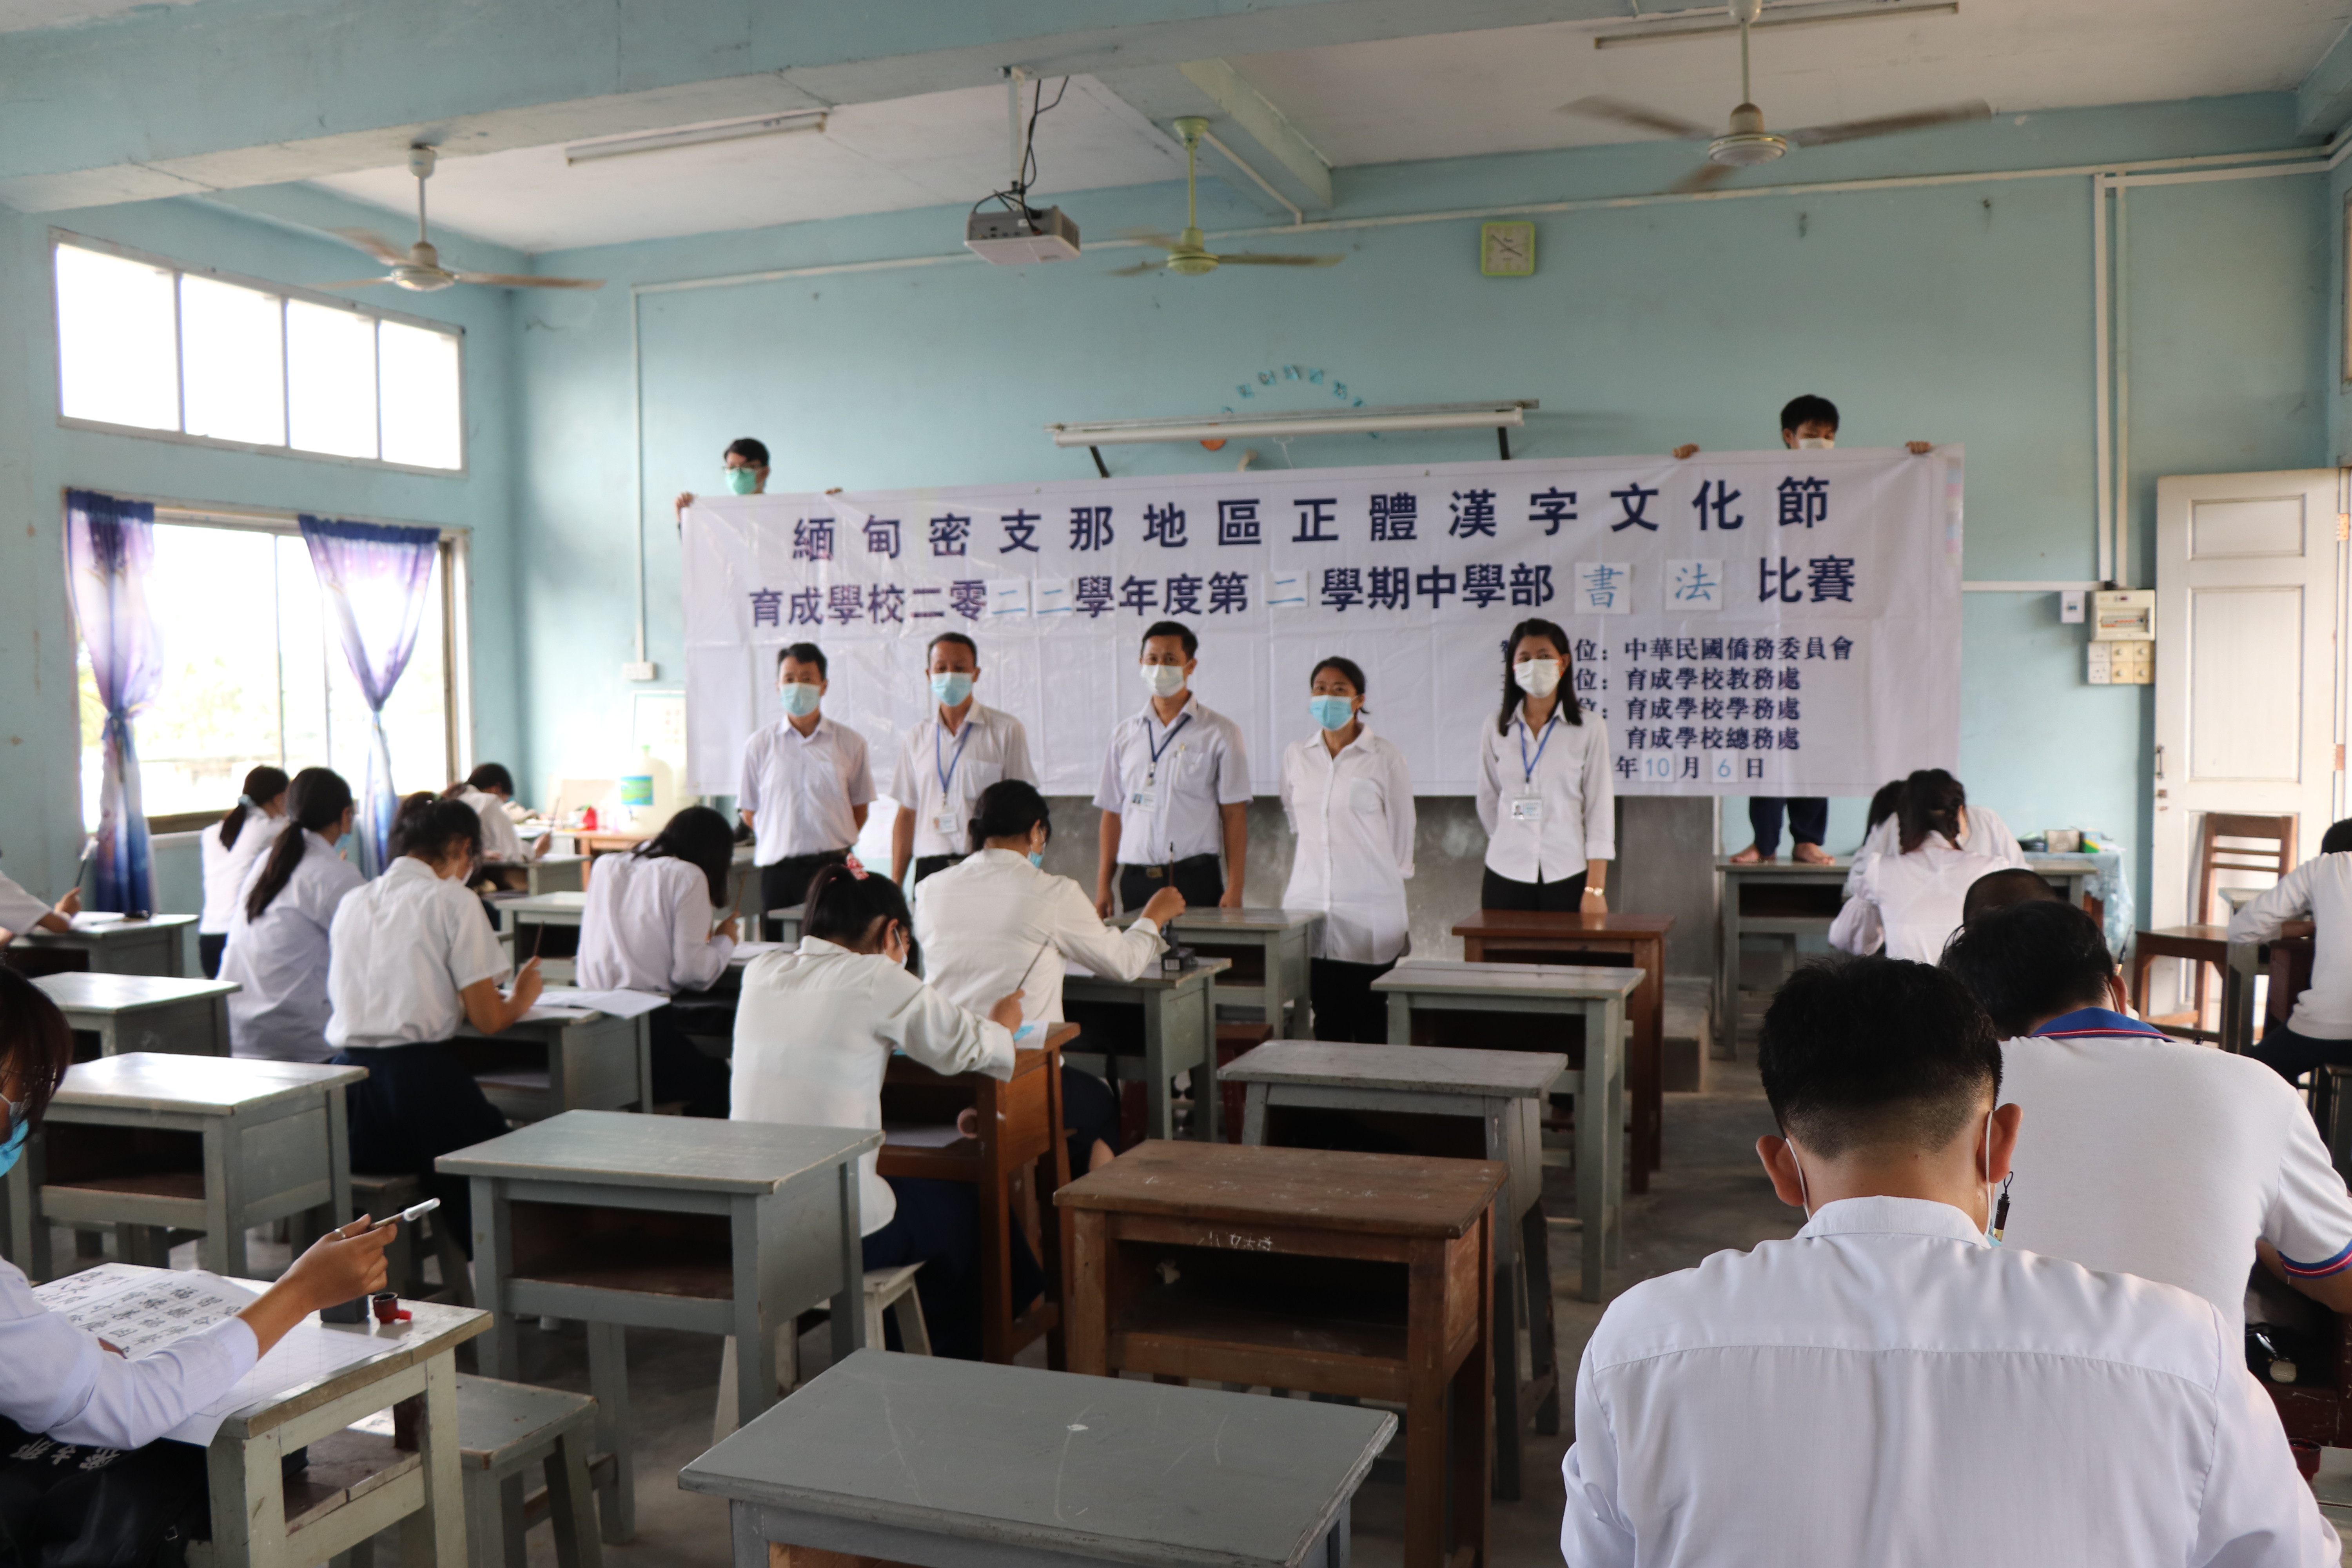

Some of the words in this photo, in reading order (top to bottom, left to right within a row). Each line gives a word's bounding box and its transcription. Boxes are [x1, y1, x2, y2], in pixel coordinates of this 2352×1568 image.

[792, 475, 1829, 562] 緬甸密支那地區正體漢字文化節
[1625, 635, 1854, 661] 中華民國僑務委員會
[1625, 667, 1800, 690] 育成學校教務處
[1625, 696, 1800, 720] 育成學校學務處
[1625, 726, 1800, 750] 育成學校總務處
